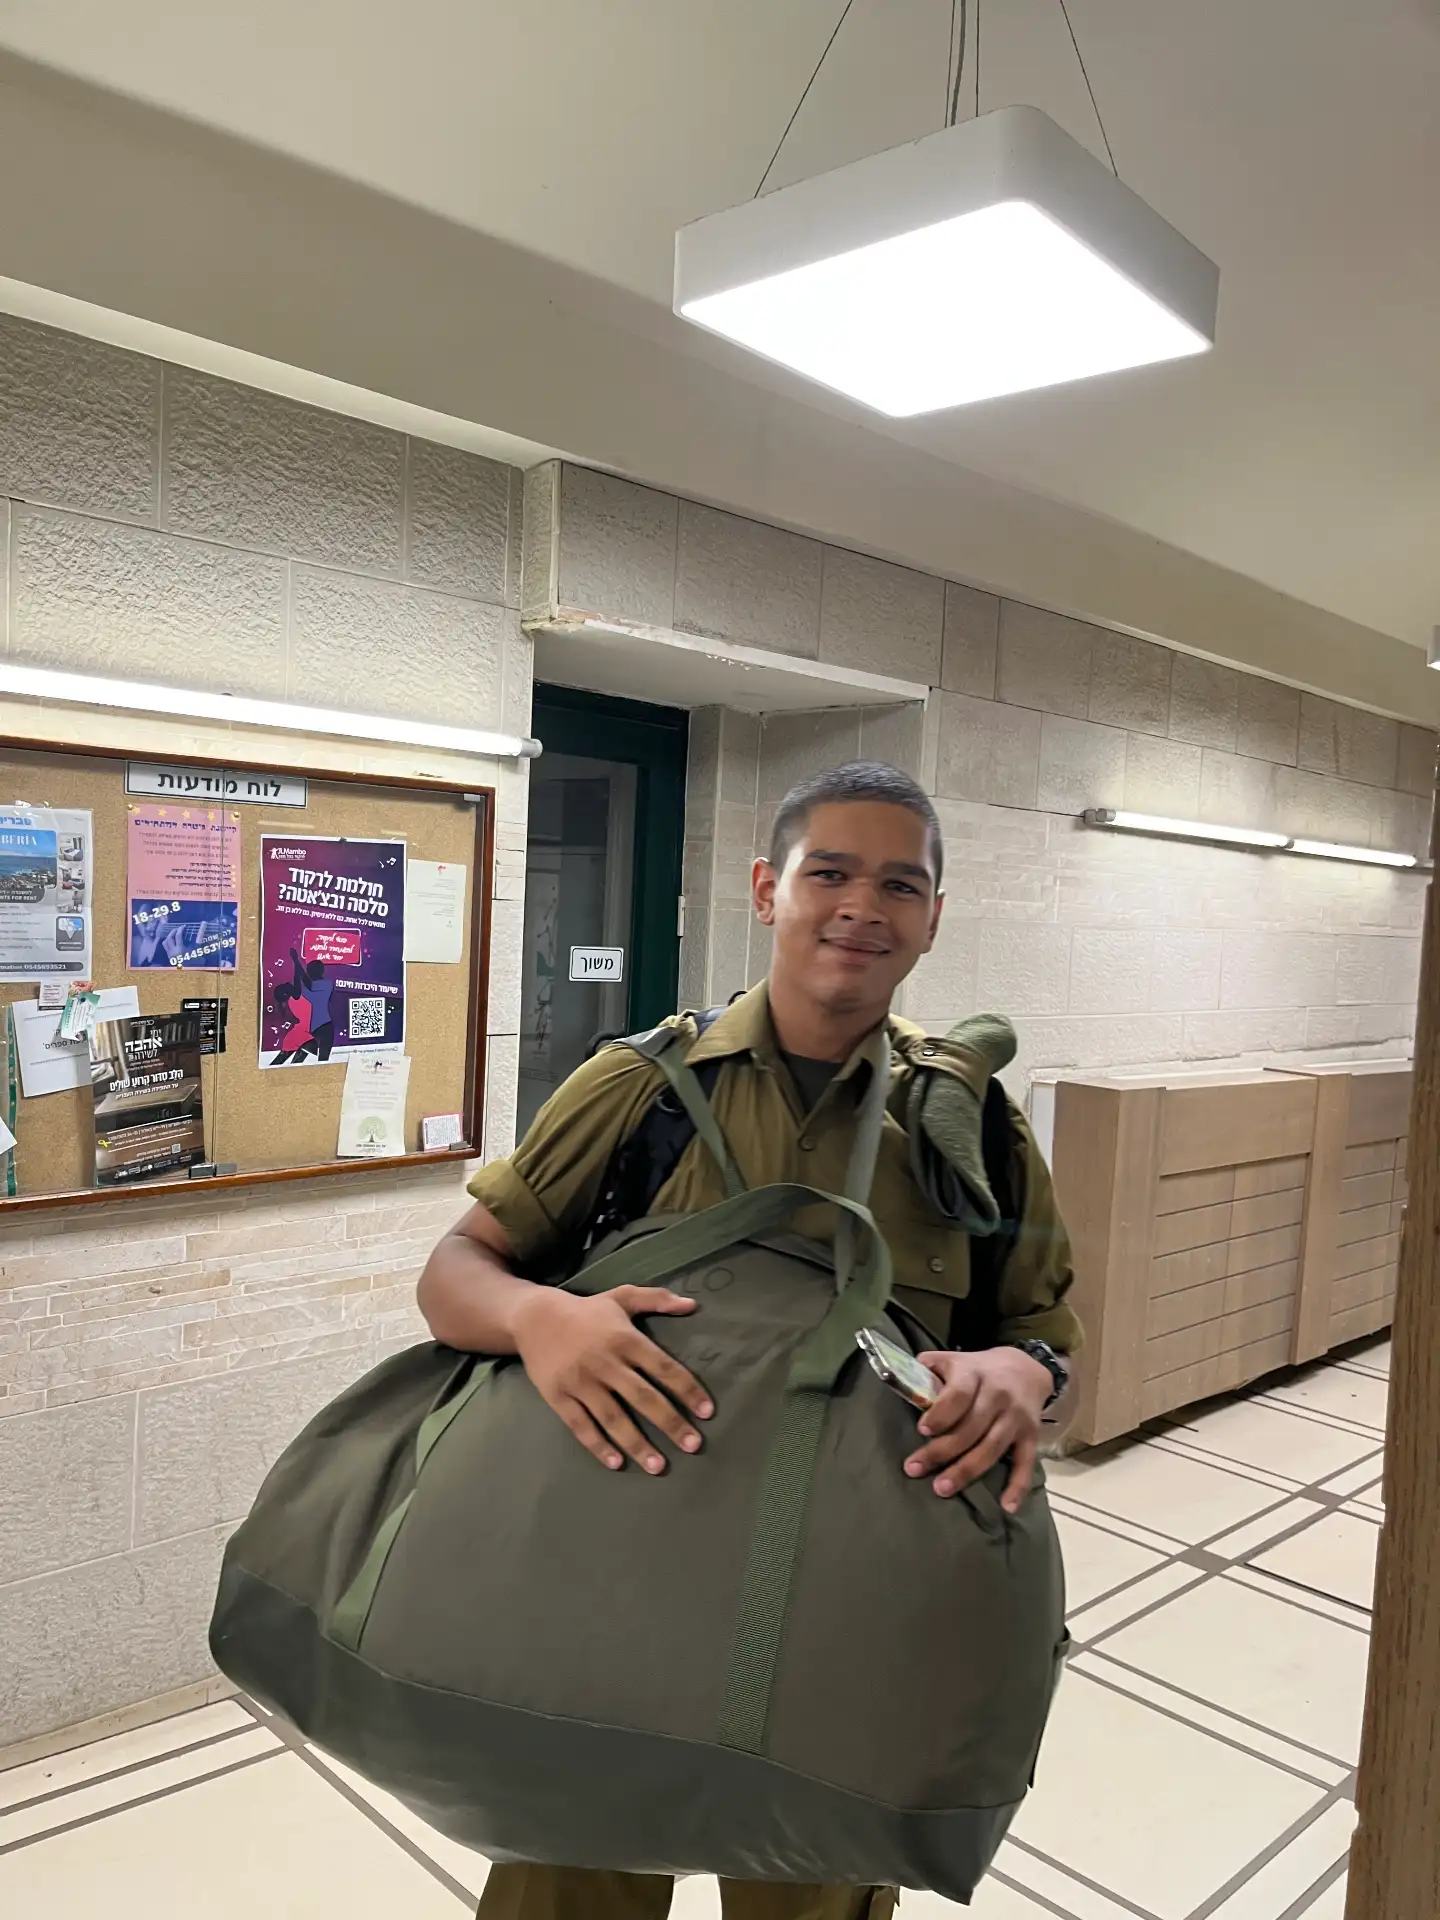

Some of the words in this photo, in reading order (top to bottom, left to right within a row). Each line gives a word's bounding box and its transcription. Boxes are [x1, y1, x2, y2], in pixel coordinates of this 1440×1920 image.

[158, 773, 238, 795] מודעות
[248, 779, 281, 797] לוח
[134, 819, 177, 829] למתחילים
[289, 867, 333, 889] לרקוד
[335, 877, 383, 897] חולמת
[133, 901, 180, 925] 18-29.8
[347, 896, 389, 917] סלסה
[325, 913, 336, 921] ללא
[358, 918, 368, 926] לכל
[368, 920, 386, 928] מתאים
[580, 957, 613, 973] משוך
[335, 979, 353, 988] חינם!
[354, 982, 377, 992] היכרות
[378, 984, 398, 994] שיעור
[125, 1037, 163, 1053] אהבה
